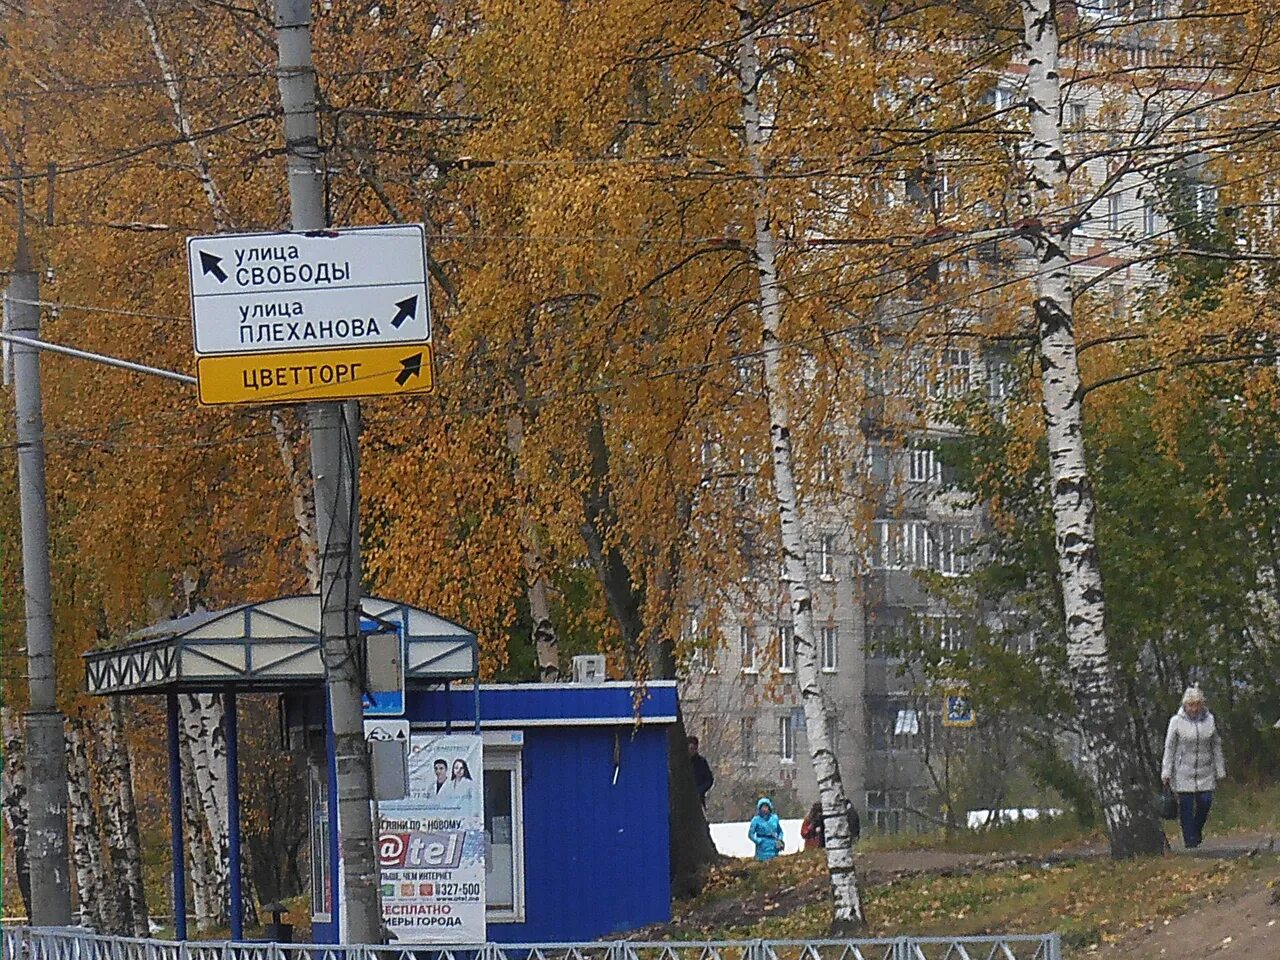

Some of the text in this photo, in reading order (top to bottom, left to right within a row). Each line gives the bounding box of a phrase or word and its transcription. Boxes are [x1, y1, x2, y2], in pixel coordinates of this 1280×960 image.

[235, 245, 299, 265] улица
[236, 262, 350, 286] СВОБОДЫ
[239, 301, 304, 322] улица
[240, 318, 381, 343] ПЛЕХАНОВА
[243, 363, 362, 390] ЦВЕТТОРГ
[427, 820, 461, 830] НОВОМУ
[419, 871, 452, 881] ИНТЕРНЕТ
[382, 904, 452, 916] ЕСПЛАТНО
[417, 917, 462, 927] ГОРОДА
